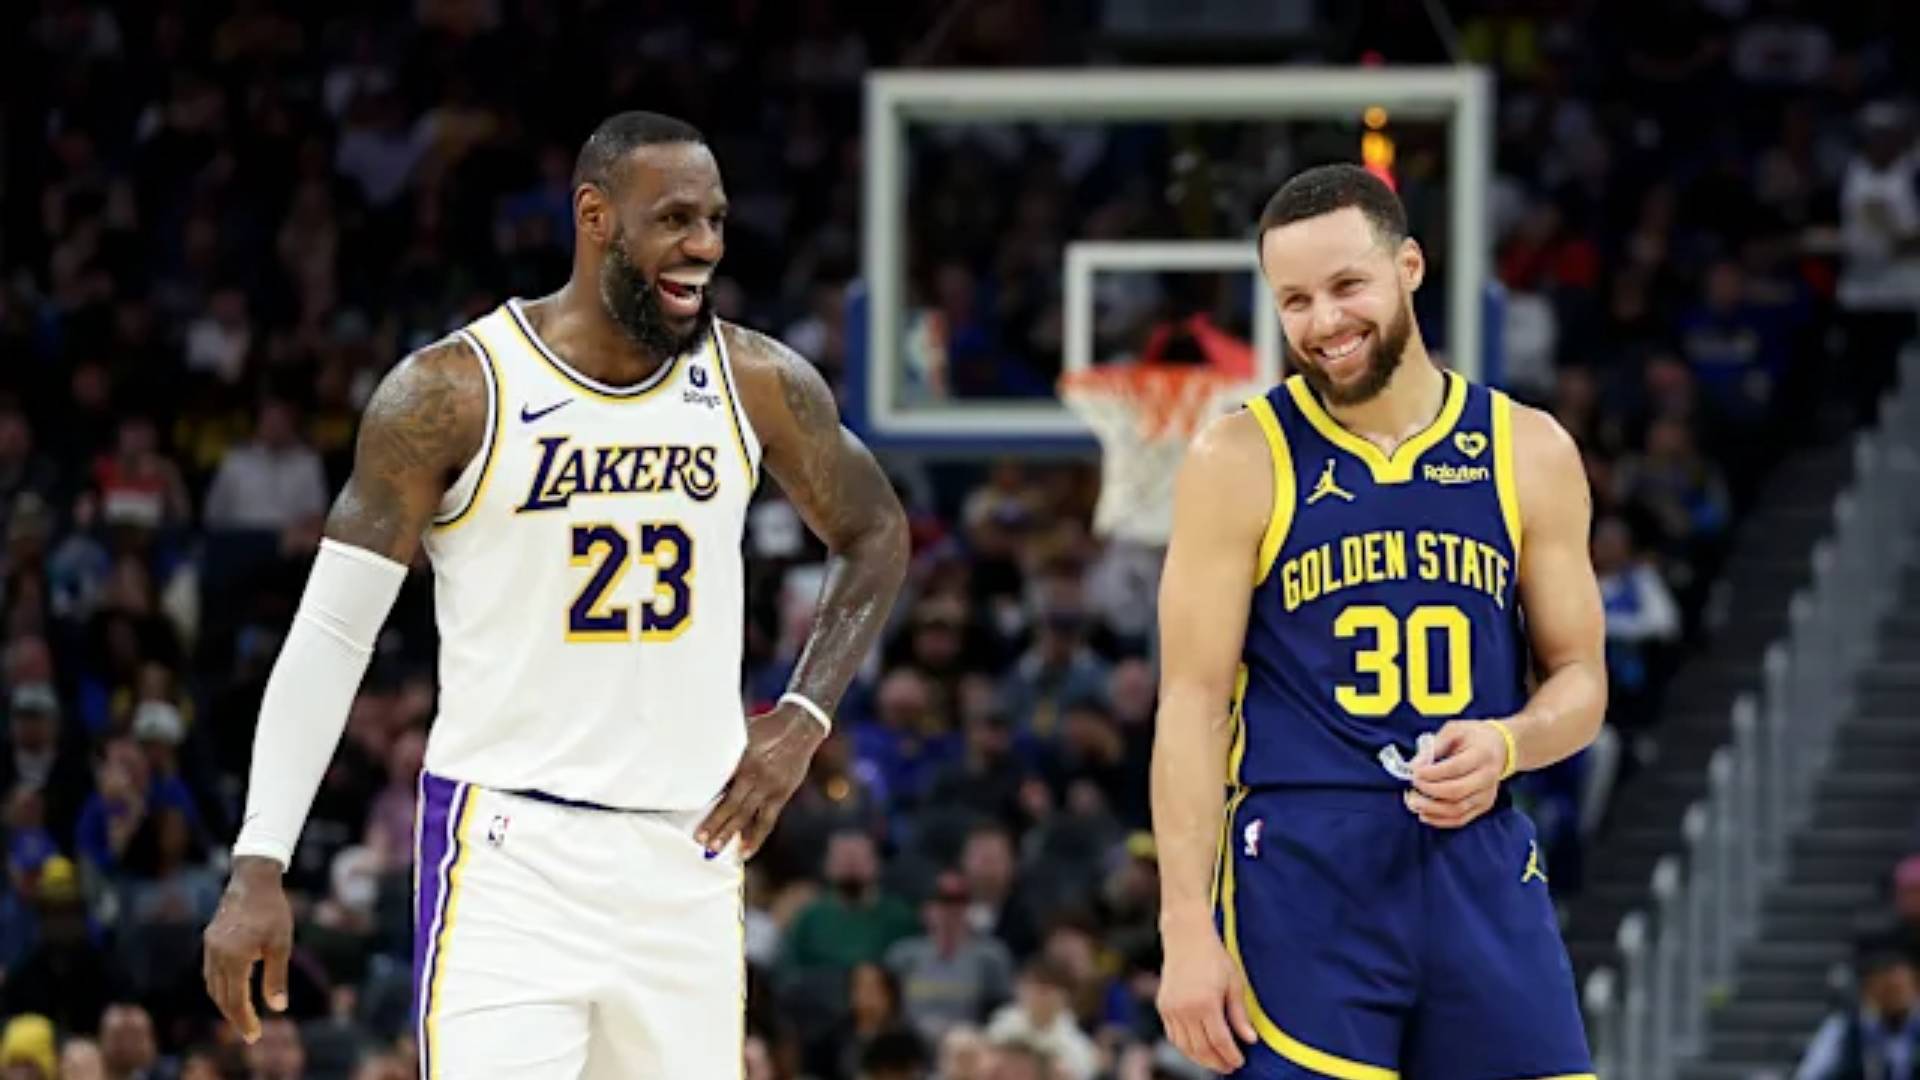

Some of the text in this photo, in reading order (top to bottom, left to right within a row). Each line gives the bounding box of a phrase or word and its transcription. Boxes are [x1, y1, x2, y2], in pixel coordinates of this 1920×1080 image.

[514, 435, 719, 514] LAKERS
[1423, 463, 1490, 484] Rakuten
[565, 523, 695, 643] 23
[1281, 530, 1510, 613] GOLDEN STATE
[1333, 605, 1474, 717] 30
